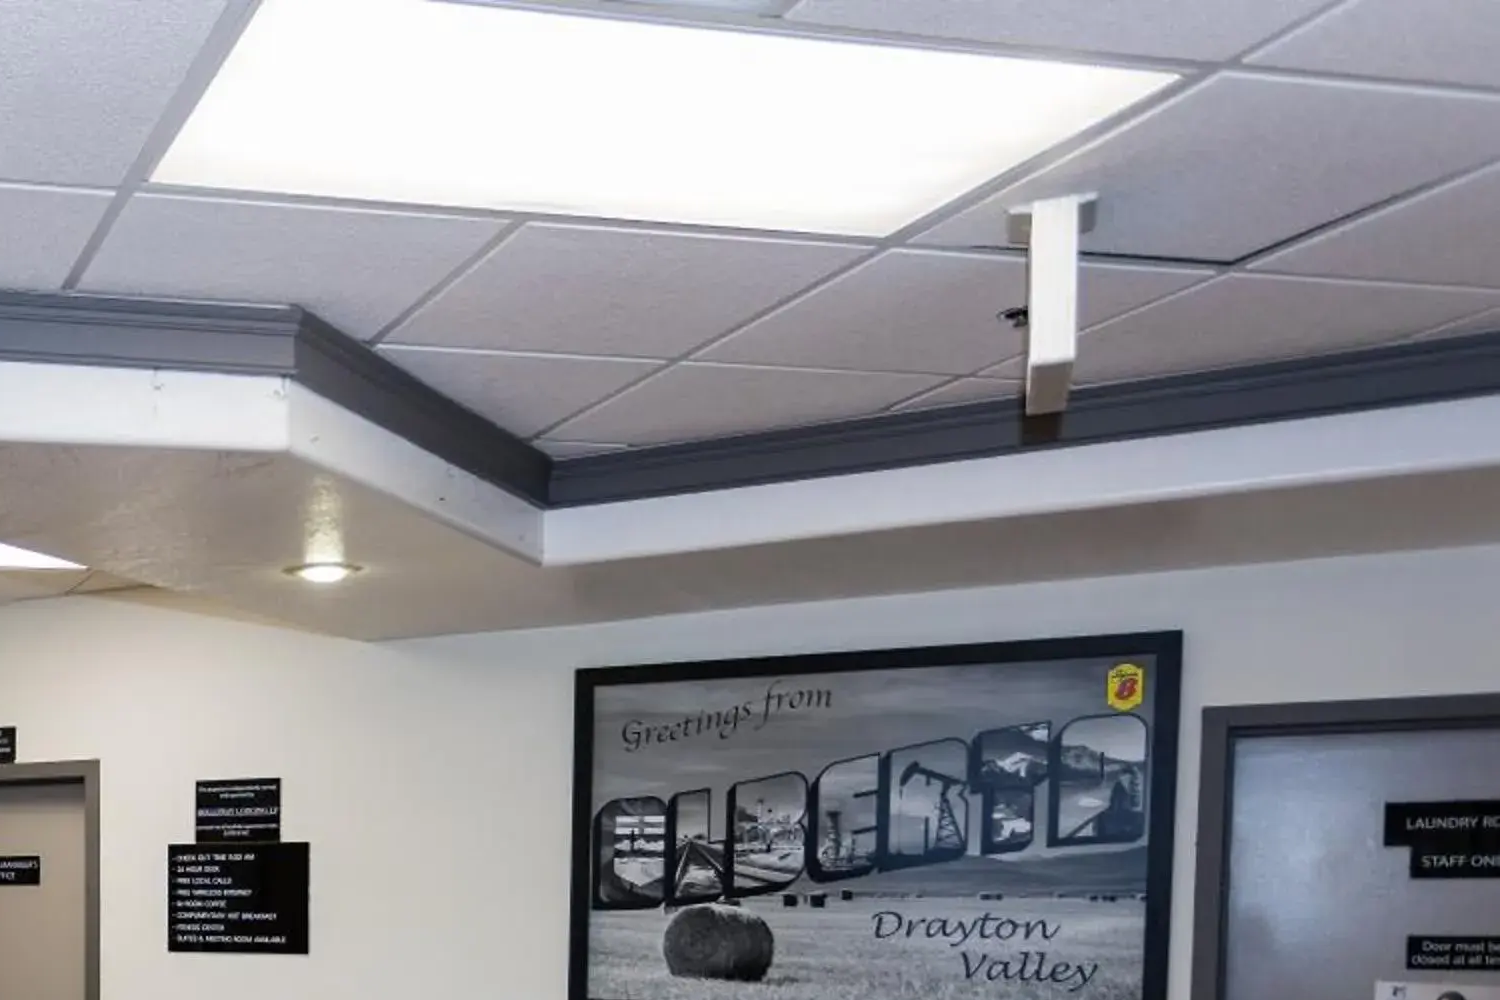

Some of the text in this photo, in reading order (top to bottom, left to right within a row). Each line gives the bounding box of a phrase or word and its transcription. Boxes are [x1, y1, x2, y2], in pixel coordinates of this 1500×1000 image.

[622, 679, 832, 752] Greetings from
[1406, 816, 1479, 830] LAUNDRY
[1422, 855, 1468, 869] STAFF
[871, 910, 1061, 947] Drayton
[1422, 941, 1451, 952] Door
[1454, 942, 1485, 953] must
[1411, 955, 1450, 966] closed
[961, 951, 1099, 992] Valley
